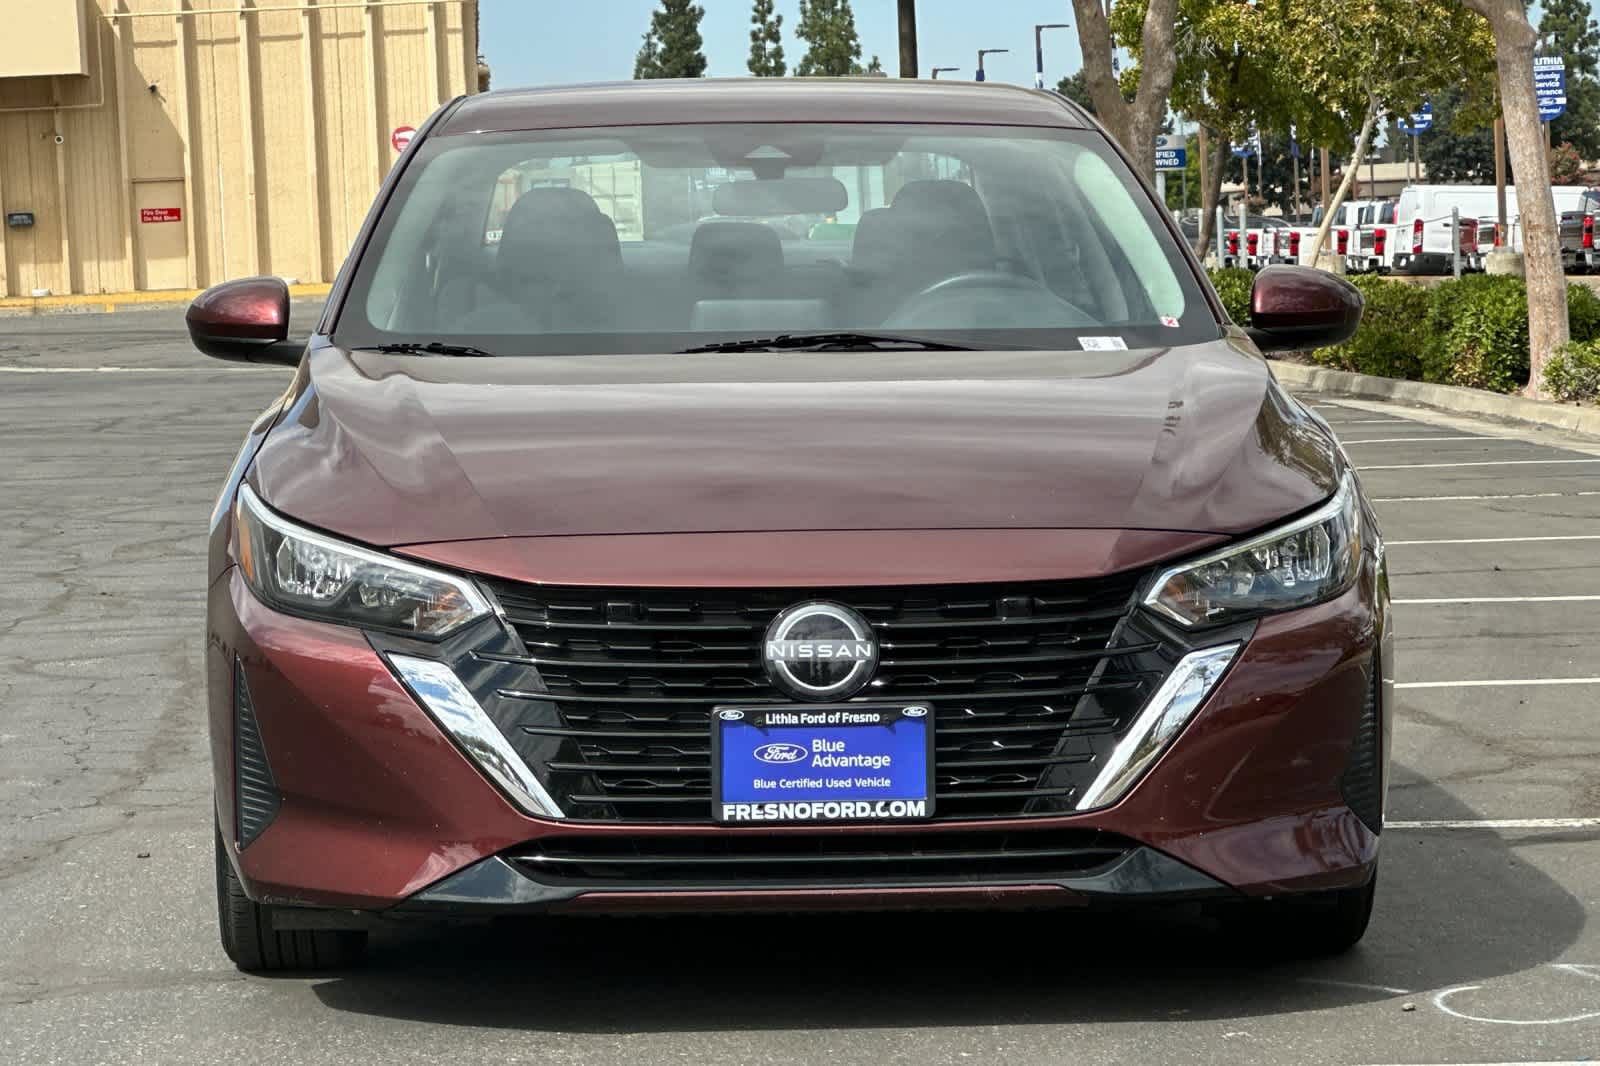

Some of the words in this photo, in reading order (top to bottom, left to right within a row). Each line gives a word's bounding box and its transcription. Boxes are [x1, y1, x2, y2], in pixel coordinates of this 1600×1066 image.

[1155, 158, 1179, 166] WNED
[768, 644, 872, 658] NISSAN
[765, 713, 798, 725] Lithia
[800, 712, 827, 724] Ford
[827, 712, 841, 724] of
[842, 711, 881, 723] Fresno
[763, 745, 798, 761] Ford
[812, 739, 845, 753] Blue
[812, 754, 891, 769] Advantage
[753, 779, 777, 789] Blue
[779, 778, 822, 789] Certified
[825, 778, 852, 788] Used
[854, 777, 891, 788] Vehicle
[722, 801, 926, 820] FRESNOFORD.COM
